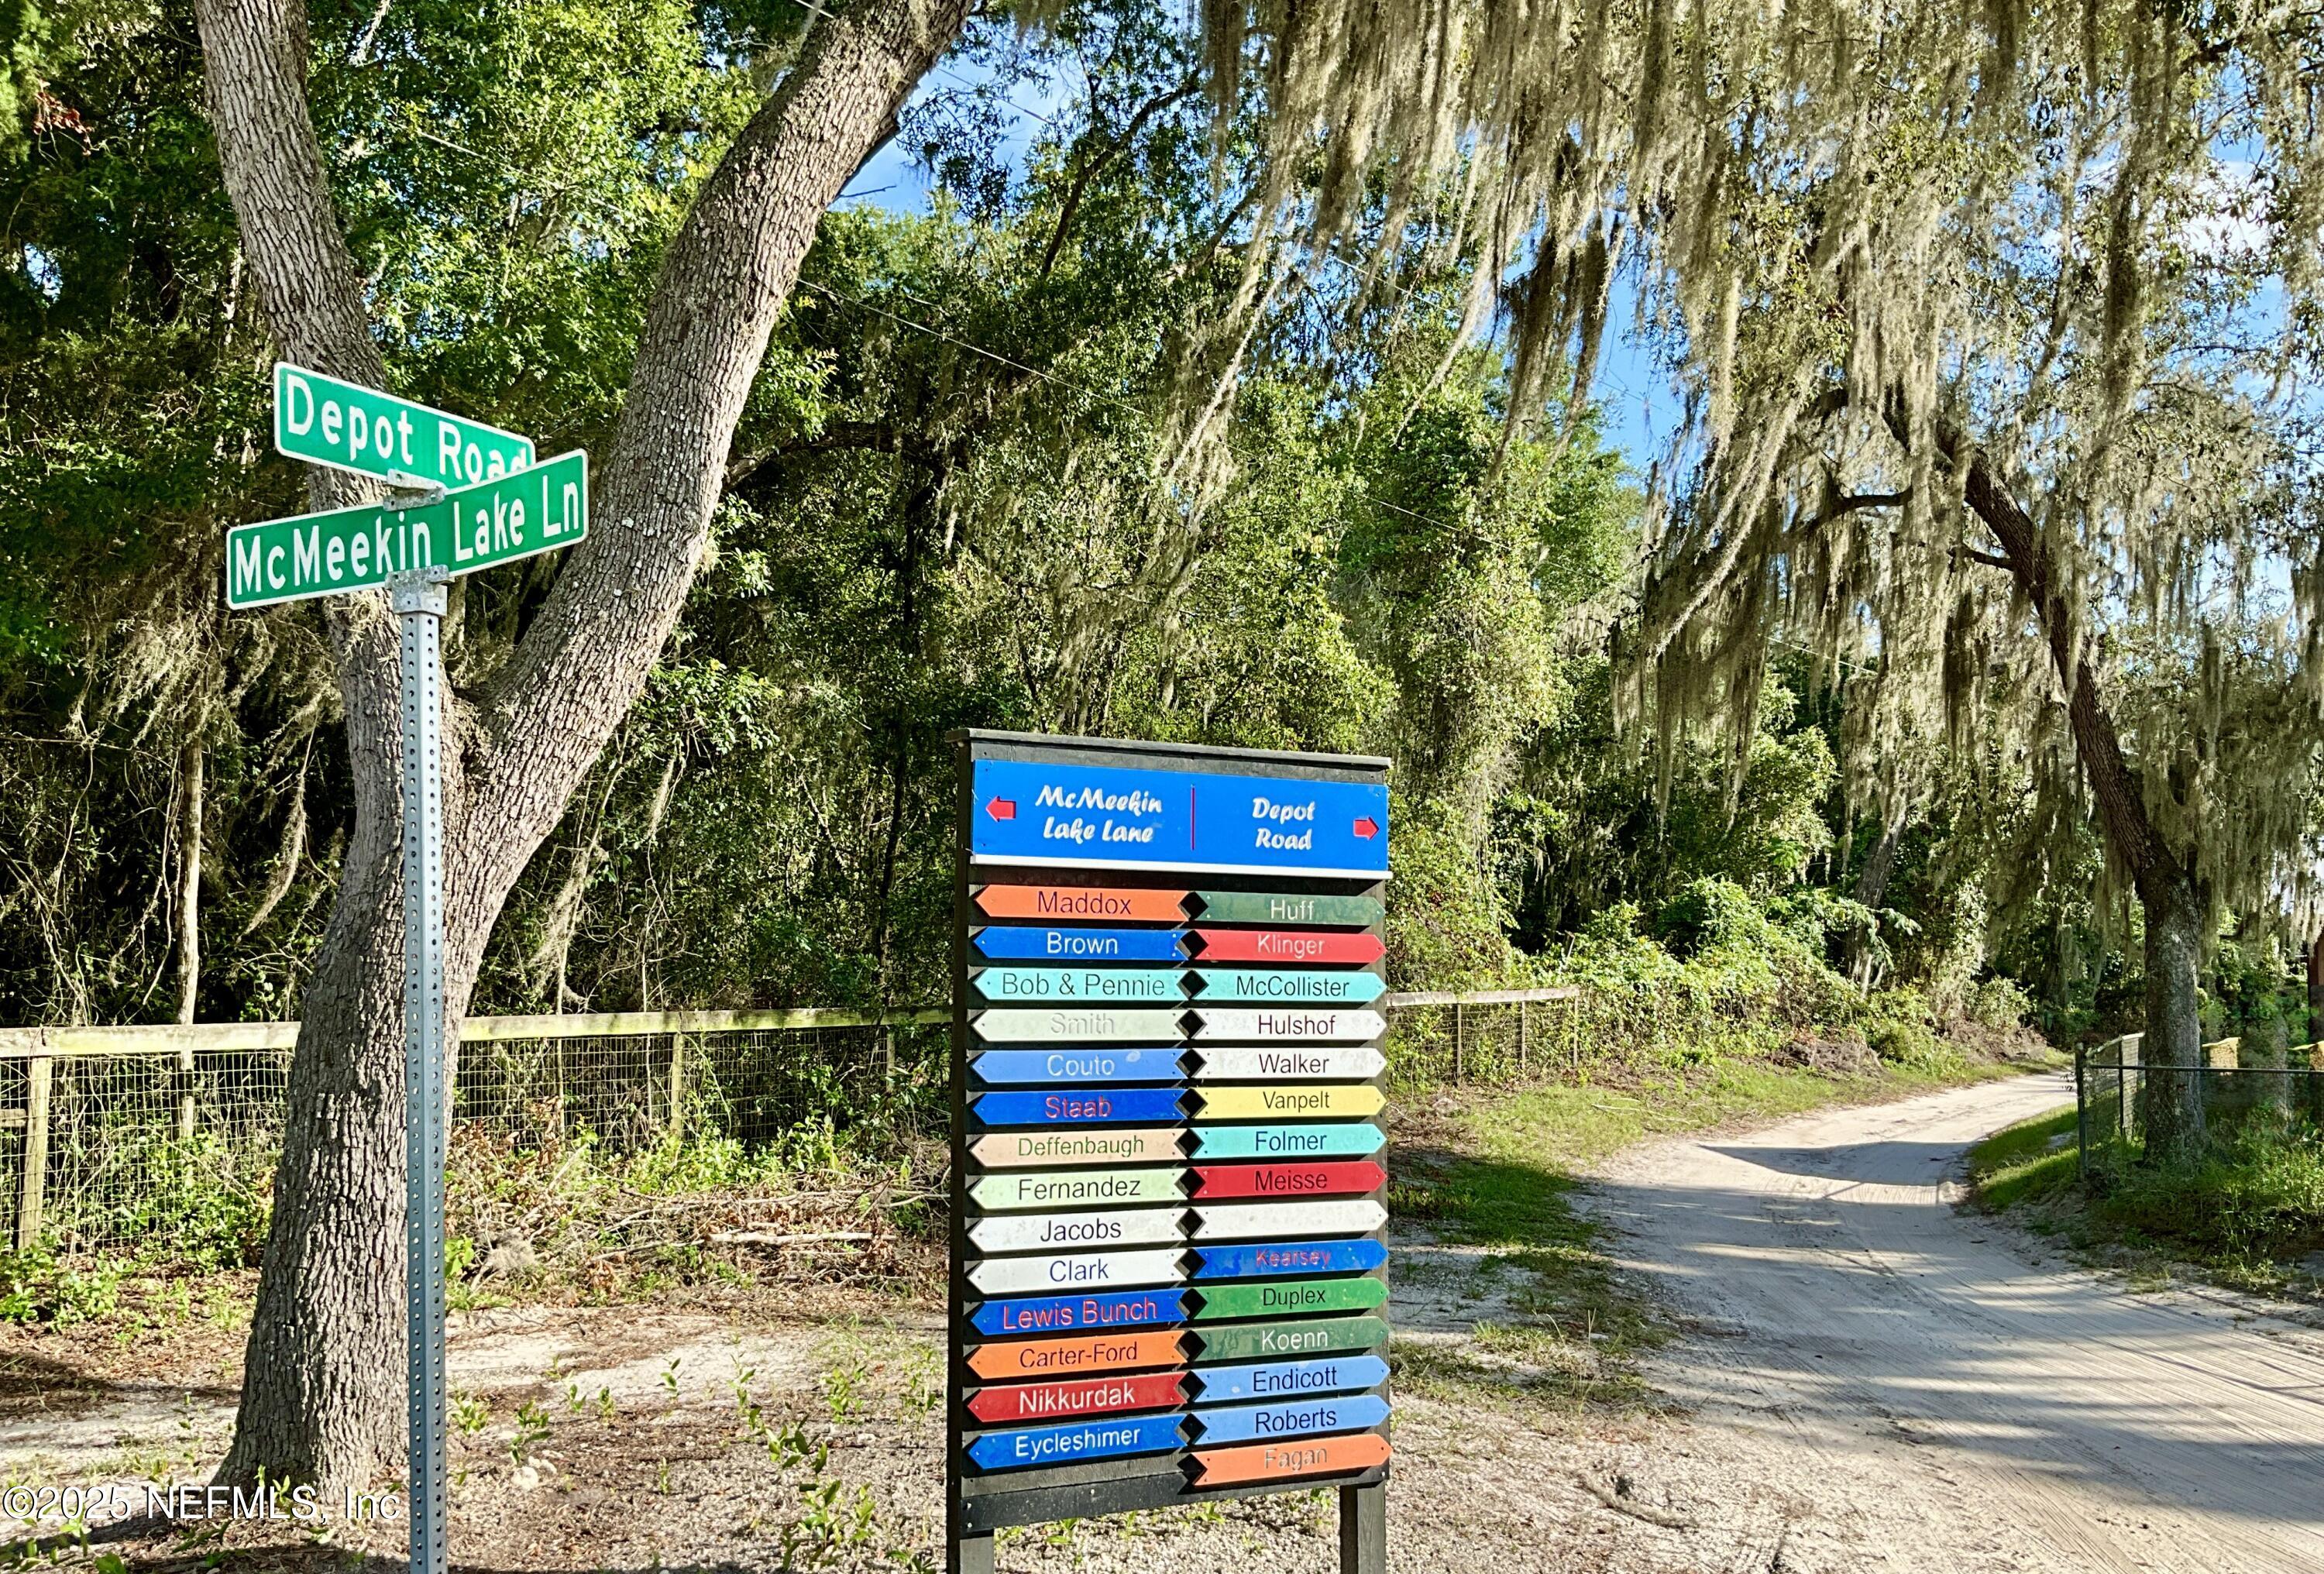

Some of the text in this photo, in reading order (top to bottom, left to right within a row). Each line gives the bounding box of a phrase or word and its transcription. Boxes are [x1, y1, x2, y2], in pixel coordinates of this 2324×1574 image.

[287, 374, 414, 465] Depot
[235, 475, 579, 596] McMeekin Lake Ln
[1035, 785, 1162, 816] McMeekin
[1252, 797, 1315, 824] Depot
[1043, 816, 1153, 844] Lake Lane
[1255, 827, 1312, 850] Road
[1037, 891, 1132, 916] Maddox
[1270, 899, 1314, 920] Huff
[1047, 932, 1118, 955] Brown
[1257, 933, 1325, 959] Klinger
[1002, 973, 1165, 996] Bob & Pennie
[1236, 976, 1349, 996] McCollister
[1050, 1012, 1115, 1034] Smith
[1258, 1015, 1336, 1034] Hulshof
[1047, 1054, 1115, 1076] Couto
[1259, 1053, 1329, 1074] Walker
[1045, 1095, 1112, 1119] Staab
[1263, 1091, 1330, 1112] Vanpelt
[1018, 1136, 1144, 1157] Deffenbaugh
[1255, 1131, 1327, 1151] Folmer
[1019, 1176, 1141, 1200] Fernandez
[1255, 1170, 1327, 1191] Meisse
[1040, 1218, 1122, 1242] Jacobs
[1049, 1258, 1109, 1282] Clark
[1256, 1248, 1332, 1270] Kearsey
[1263, 1286, 1326, 1309] Duplex
[1002, 1297, 1157, 1330] Lewis Bunch
[1261, 1329, 1328, 1351] Koenn
[1019, 1342, 1137, 1368] Carter-Ford
[1253, 1366, 1337, 1391] Endicott
[1019, 1382, 1136, 1414] Nikkurdak
[1255, 1407, 1337, 1433] Roberts
[1016, 1427, 1141, 1460] Eycleshimer
[1264, 1447, 1328, 1471] Fagan
